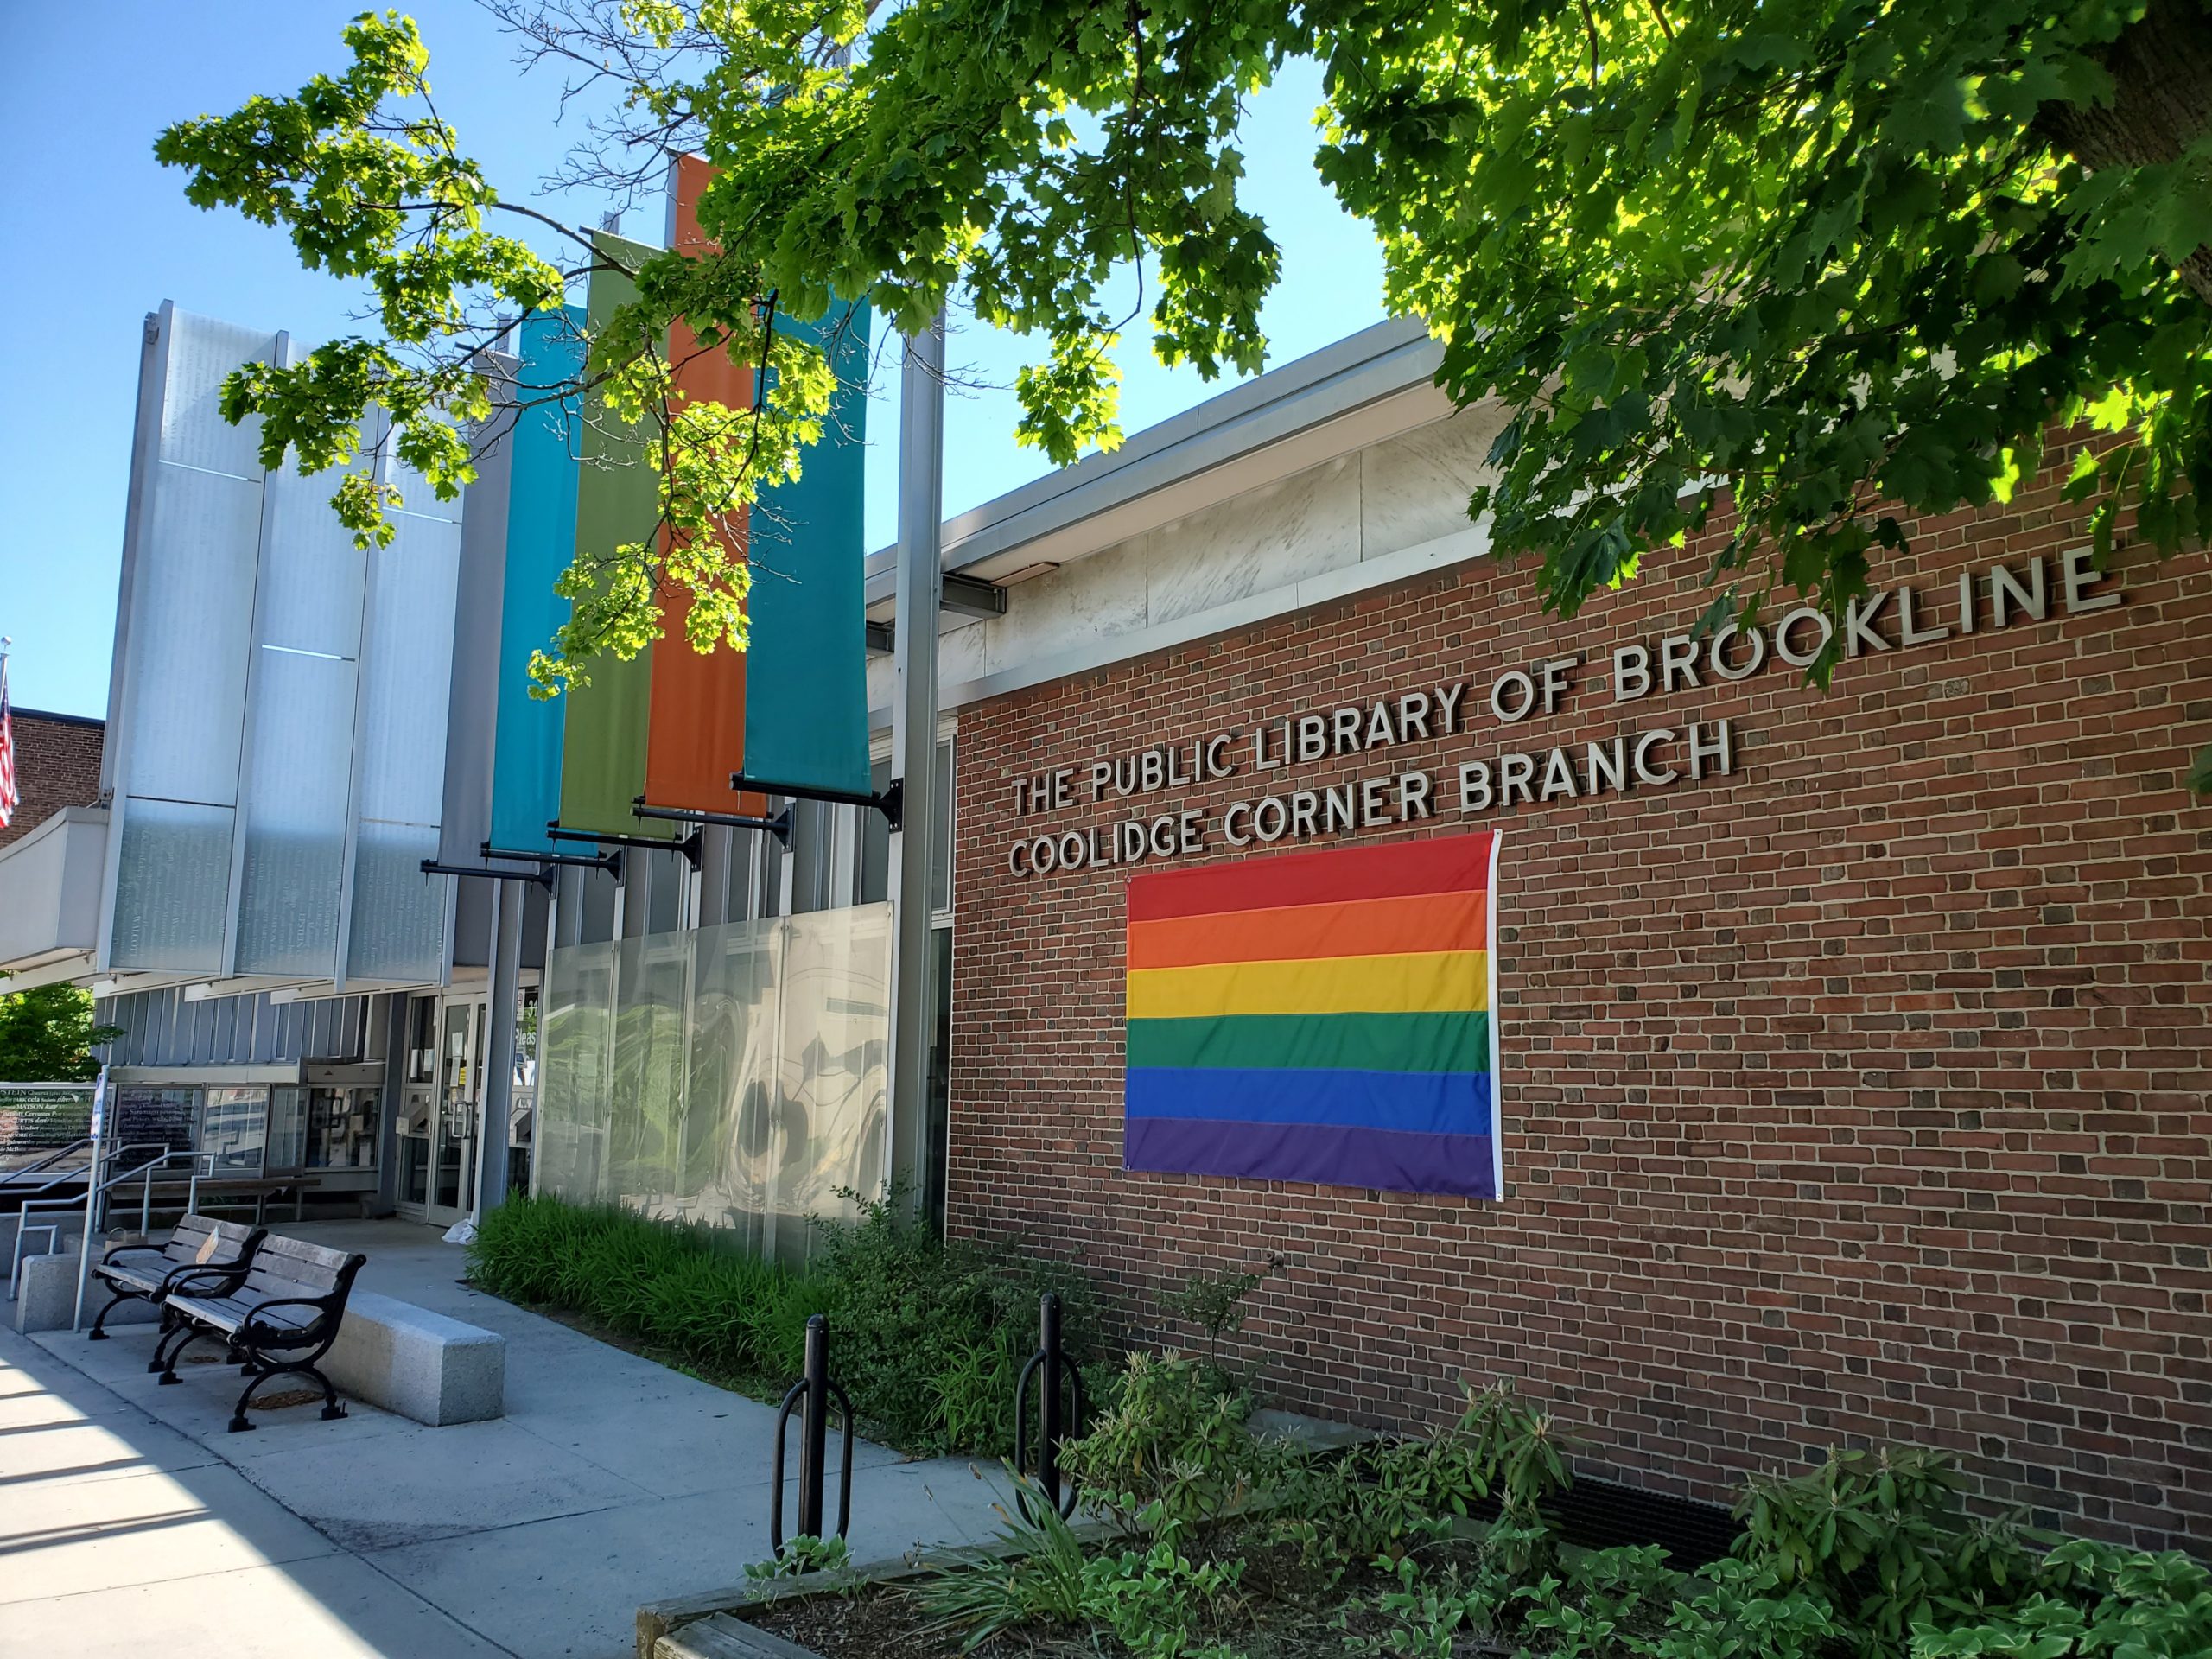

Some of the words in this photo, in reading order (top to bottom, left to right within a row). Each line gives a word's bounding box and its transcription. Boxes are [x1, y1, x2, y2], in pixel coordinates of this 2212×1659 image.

[1011, 767, 1077, 816] THE
[1092, 734, 1235, 802] PUBLIC
[1255, 683, 1464, 770] LIBRARY
[1490, 657, 1580, 723] OF
[1612, 540, 2123, 702] BROOKLINE
[1008, 810, 1204, 878] COOLIDGE
[1224, 772, 1431, 847] CORNER
[1459, 718, 1731, 813] BRANCH
